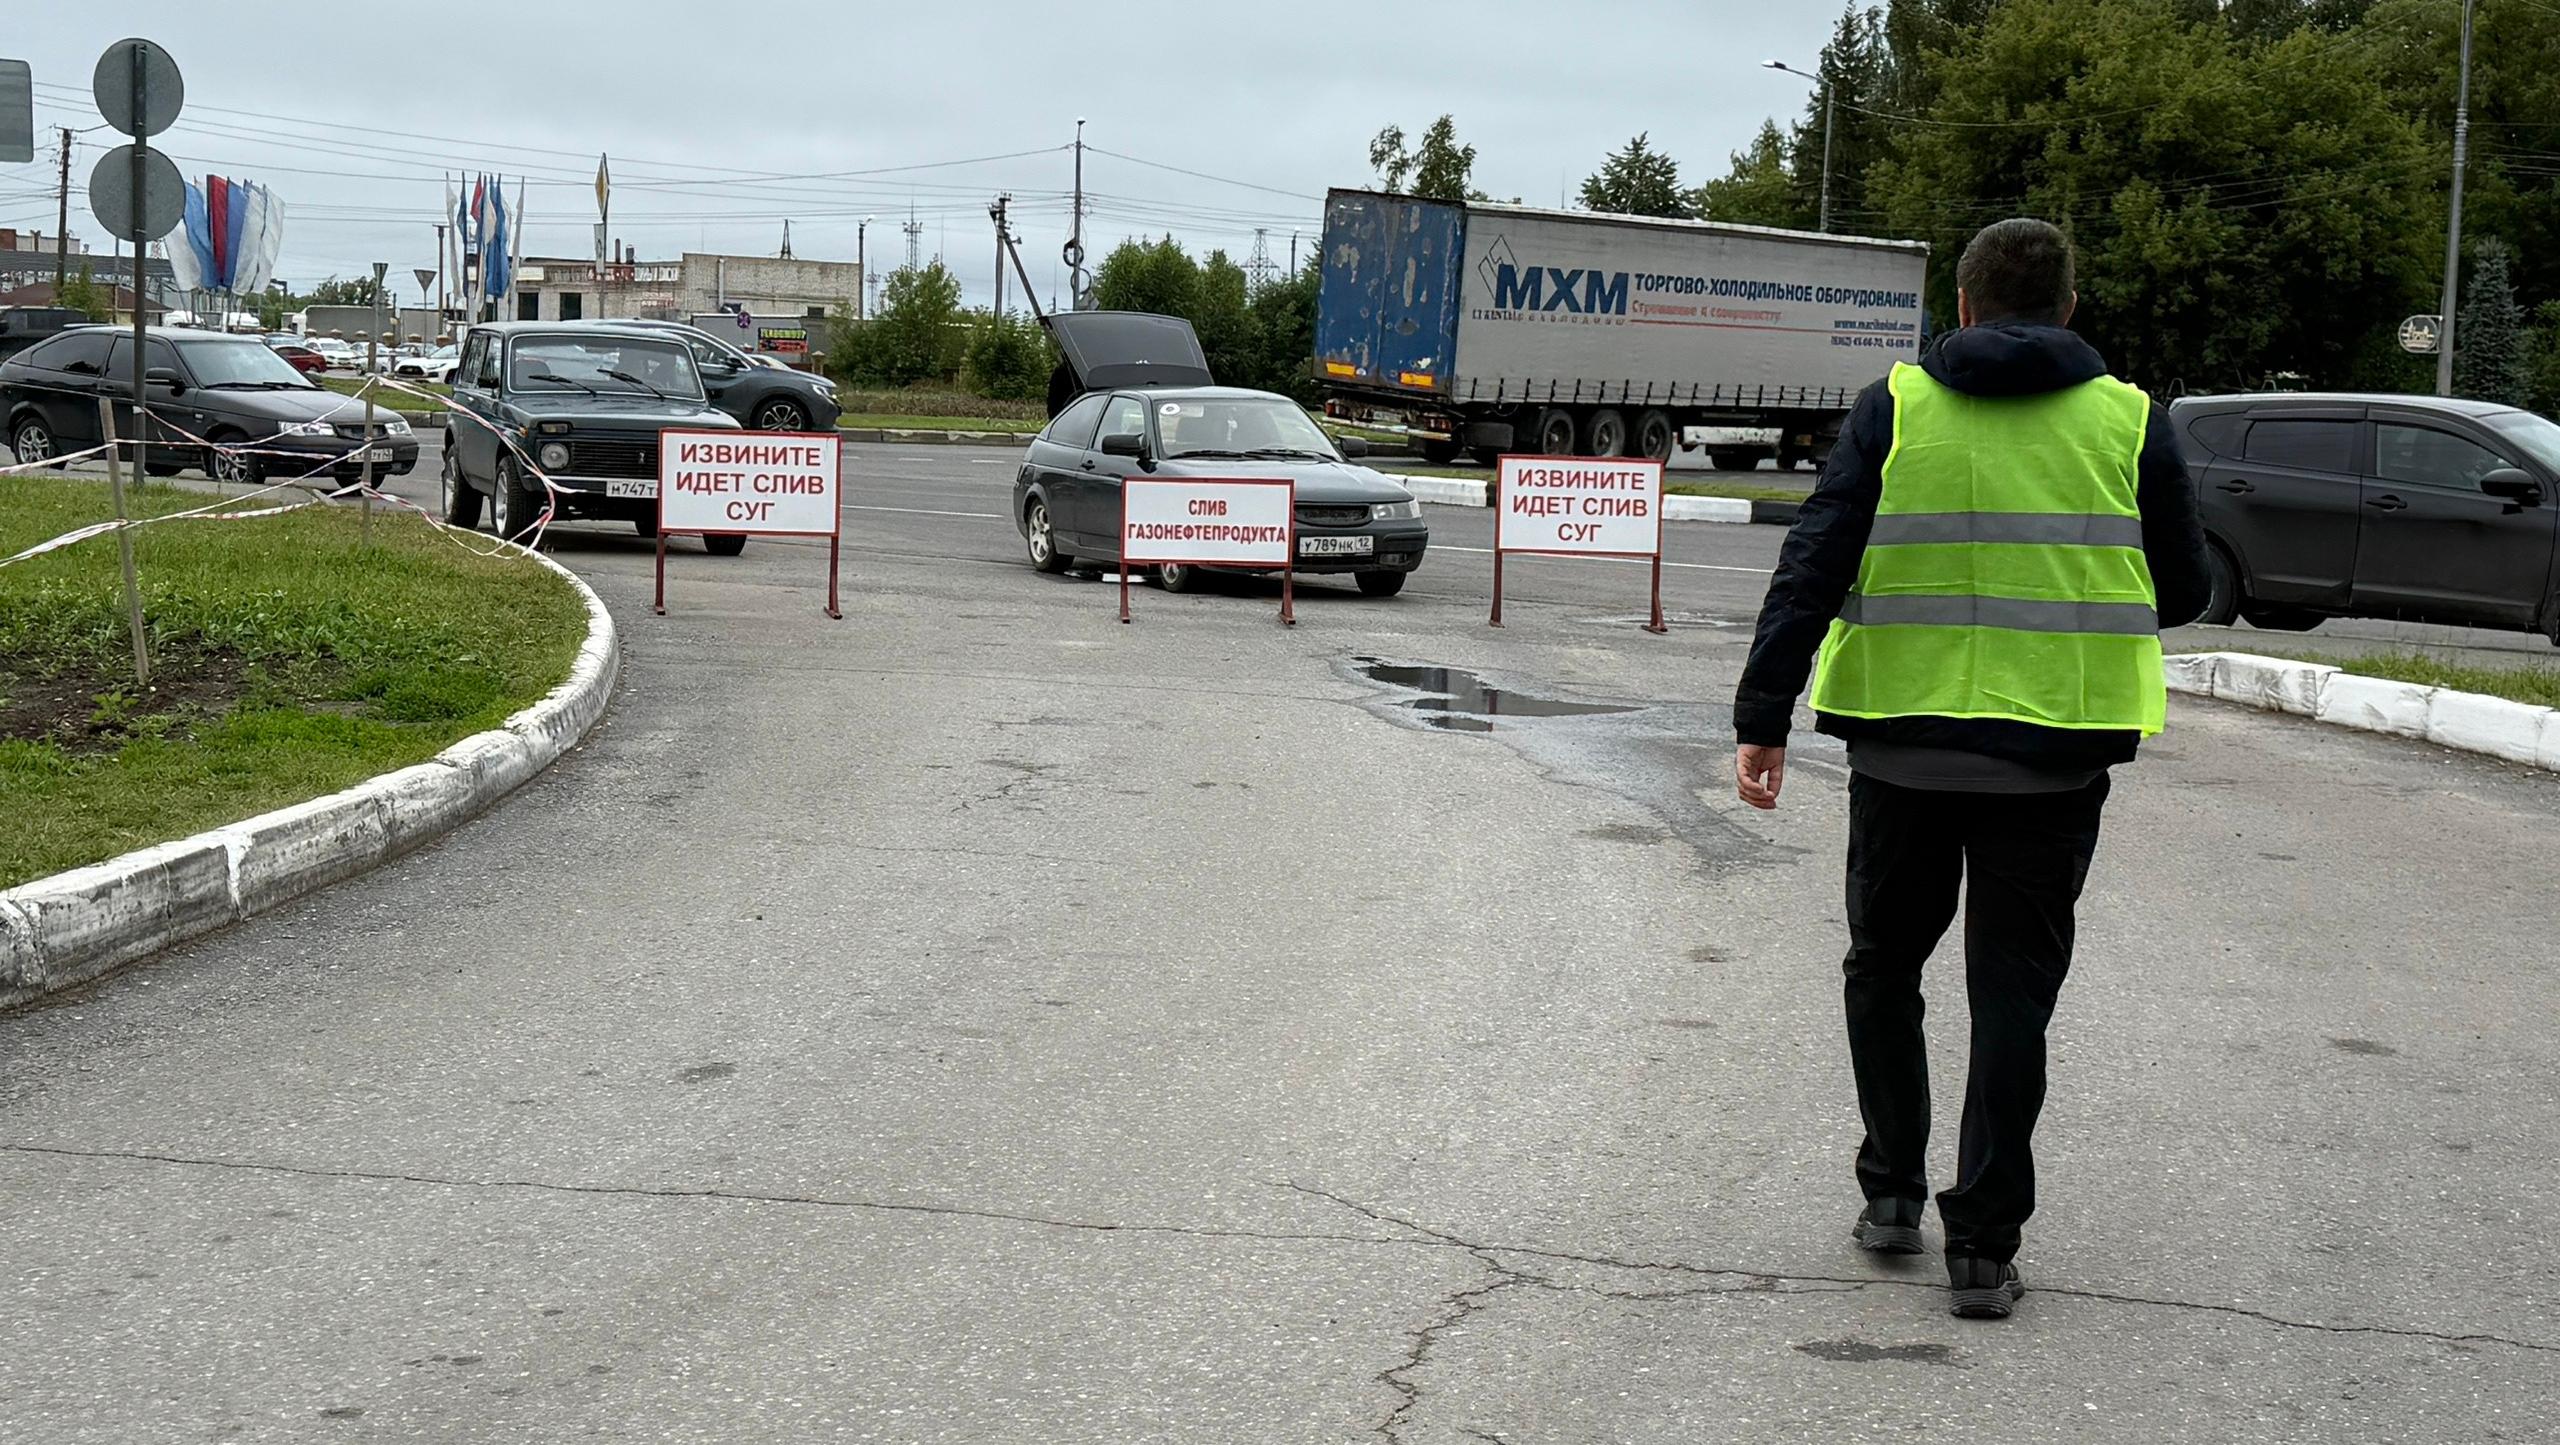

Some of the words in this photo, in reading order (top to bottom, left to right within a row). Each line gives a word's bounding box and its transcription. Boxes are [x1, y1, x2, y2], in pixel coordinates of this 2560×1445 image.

[1494, 263, 1630, 316] МХМ
[1635, 273, 1813, 302] ТОРГОВО-ХОЛОДИЛЬНОЕ
[1815, 287, 1918, 309] ОБОРУДОВАНИЕ
[680, 443, 821, 467] ИЗВИНИТЕ
[676, 471, 746, 495] ИДЕТ
[753, 474, 825, 495] СЛИВ
[1518, 468, 1646, 491] ИЗВИНИТЕ
[726, 501, 776, 521] СУГ
[1188, 499, 1228, 516] СЛИВ
[1513, 495, 1576, 518] ИДЕТ
[1582, 497, 1648, 517] СЛИВ
[1127, 523, 1287, 545] ГАЗОНЕФТЕПРОДУКТА
[1558, 523, 1603, 542] СУГ
